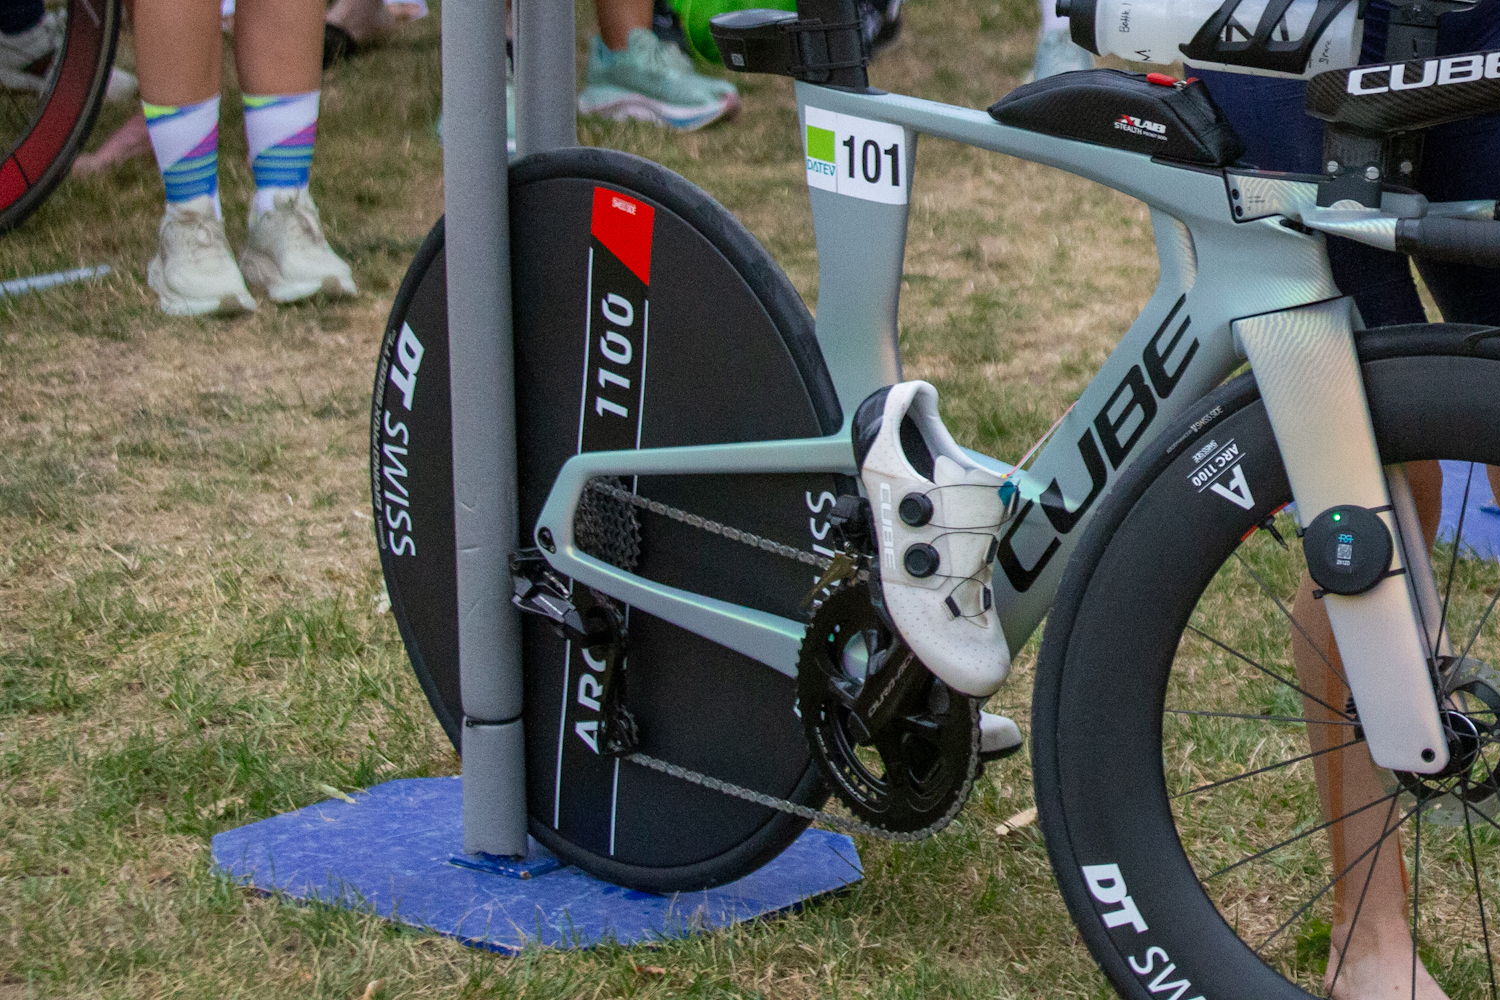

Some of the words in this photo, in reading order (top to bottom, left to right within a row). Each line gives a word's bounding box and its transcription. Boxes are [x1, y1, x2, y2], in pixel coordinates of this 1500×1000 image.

[1113, 121, 1143, 136] STEALTH
[1115, 113, 1167, 134] XLAB
[806, 158, 836, 177] DATEV
[842, 135, 900, 187] 101
[390, 320, 425, 411] DT
[595, 292, 635, 419] 1100
[996, 292, 1200, 594] CUBE
[1215, 443, 1240, 468] ARC
[383, 409, 417, 557] SWISS
[1191, 464, 1218, 487] 1100
[879, 482, 897, 571] CUBE
[1081, 862, 1150, 934] DT
